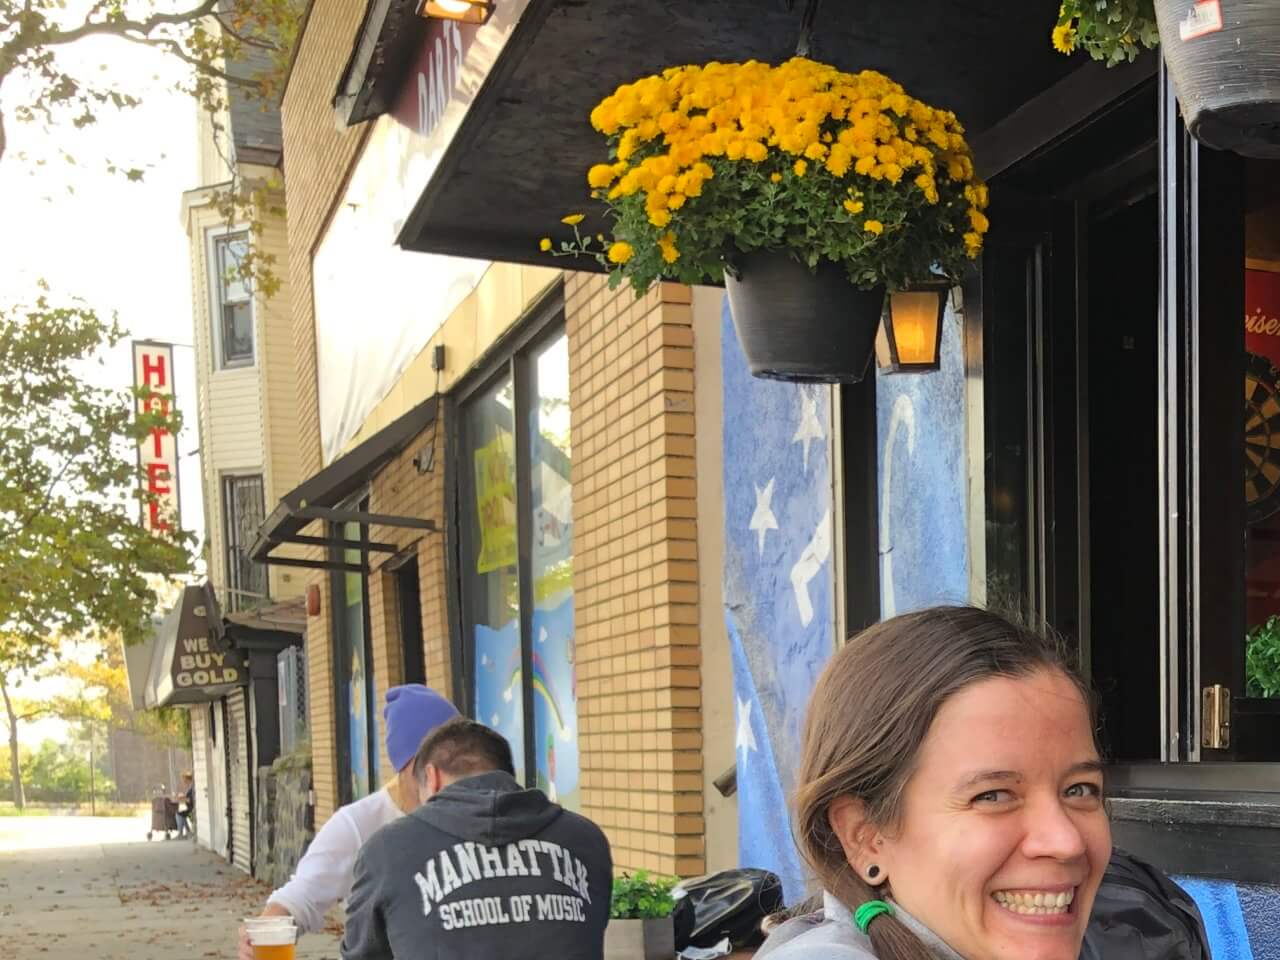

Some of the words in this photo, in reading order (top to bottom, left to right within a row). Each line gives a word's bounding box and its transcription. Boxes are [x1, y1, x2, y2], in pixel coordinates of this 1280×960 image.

[142, 353, 172, 533] HOTEL
[184, 639, 209, 652] WE
[181, 652, 227, 669] BUY
[176, 667, 238, 687] GOLD
[414, 839, 591, 916] MANHATTAN
[439, 898, 510, 931] SCHOOL
[511, 895, 533, 923] OF
[537, 894, 586, 923] MUSIC
